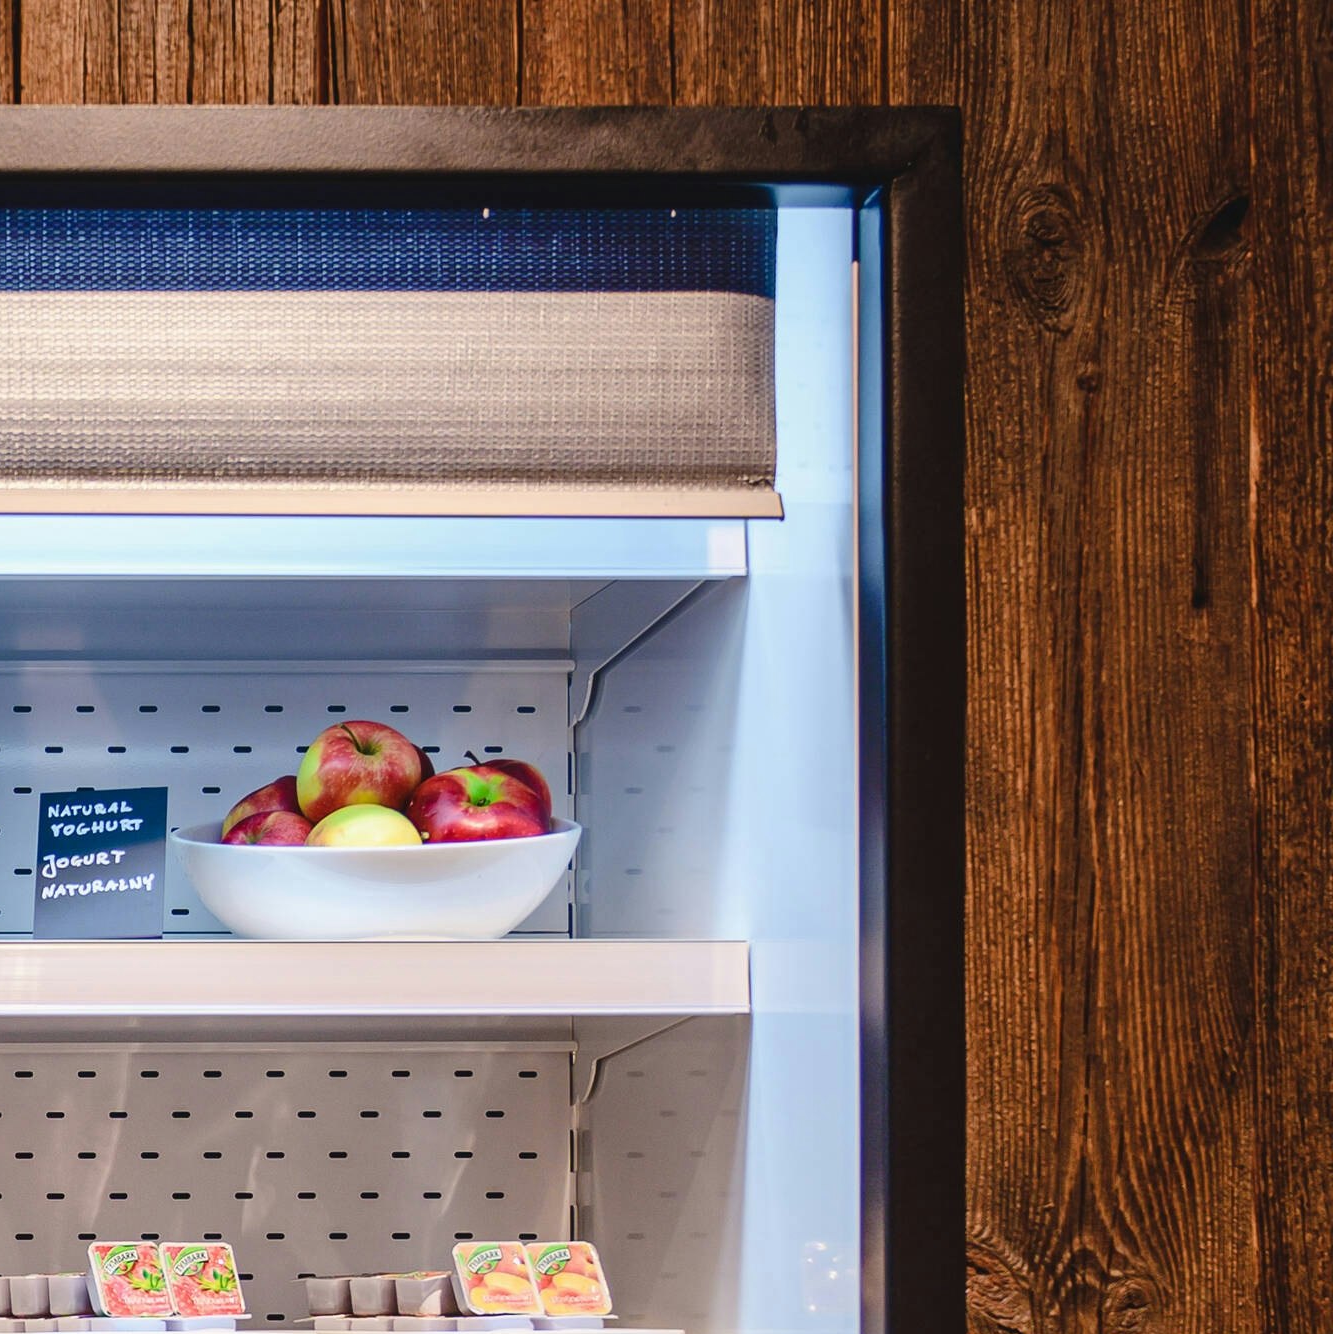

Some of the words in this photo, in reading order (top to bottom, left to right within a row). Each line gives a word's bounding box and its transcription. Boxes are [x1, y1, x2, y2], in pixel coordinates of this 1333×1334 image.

[48, 801, 133, 818] NATURAL
[51, 818, 144, 837] YOGHURT
[41, 849, 126, 878] JOGURT
[41, 873, 155, 899] NATURALNY
